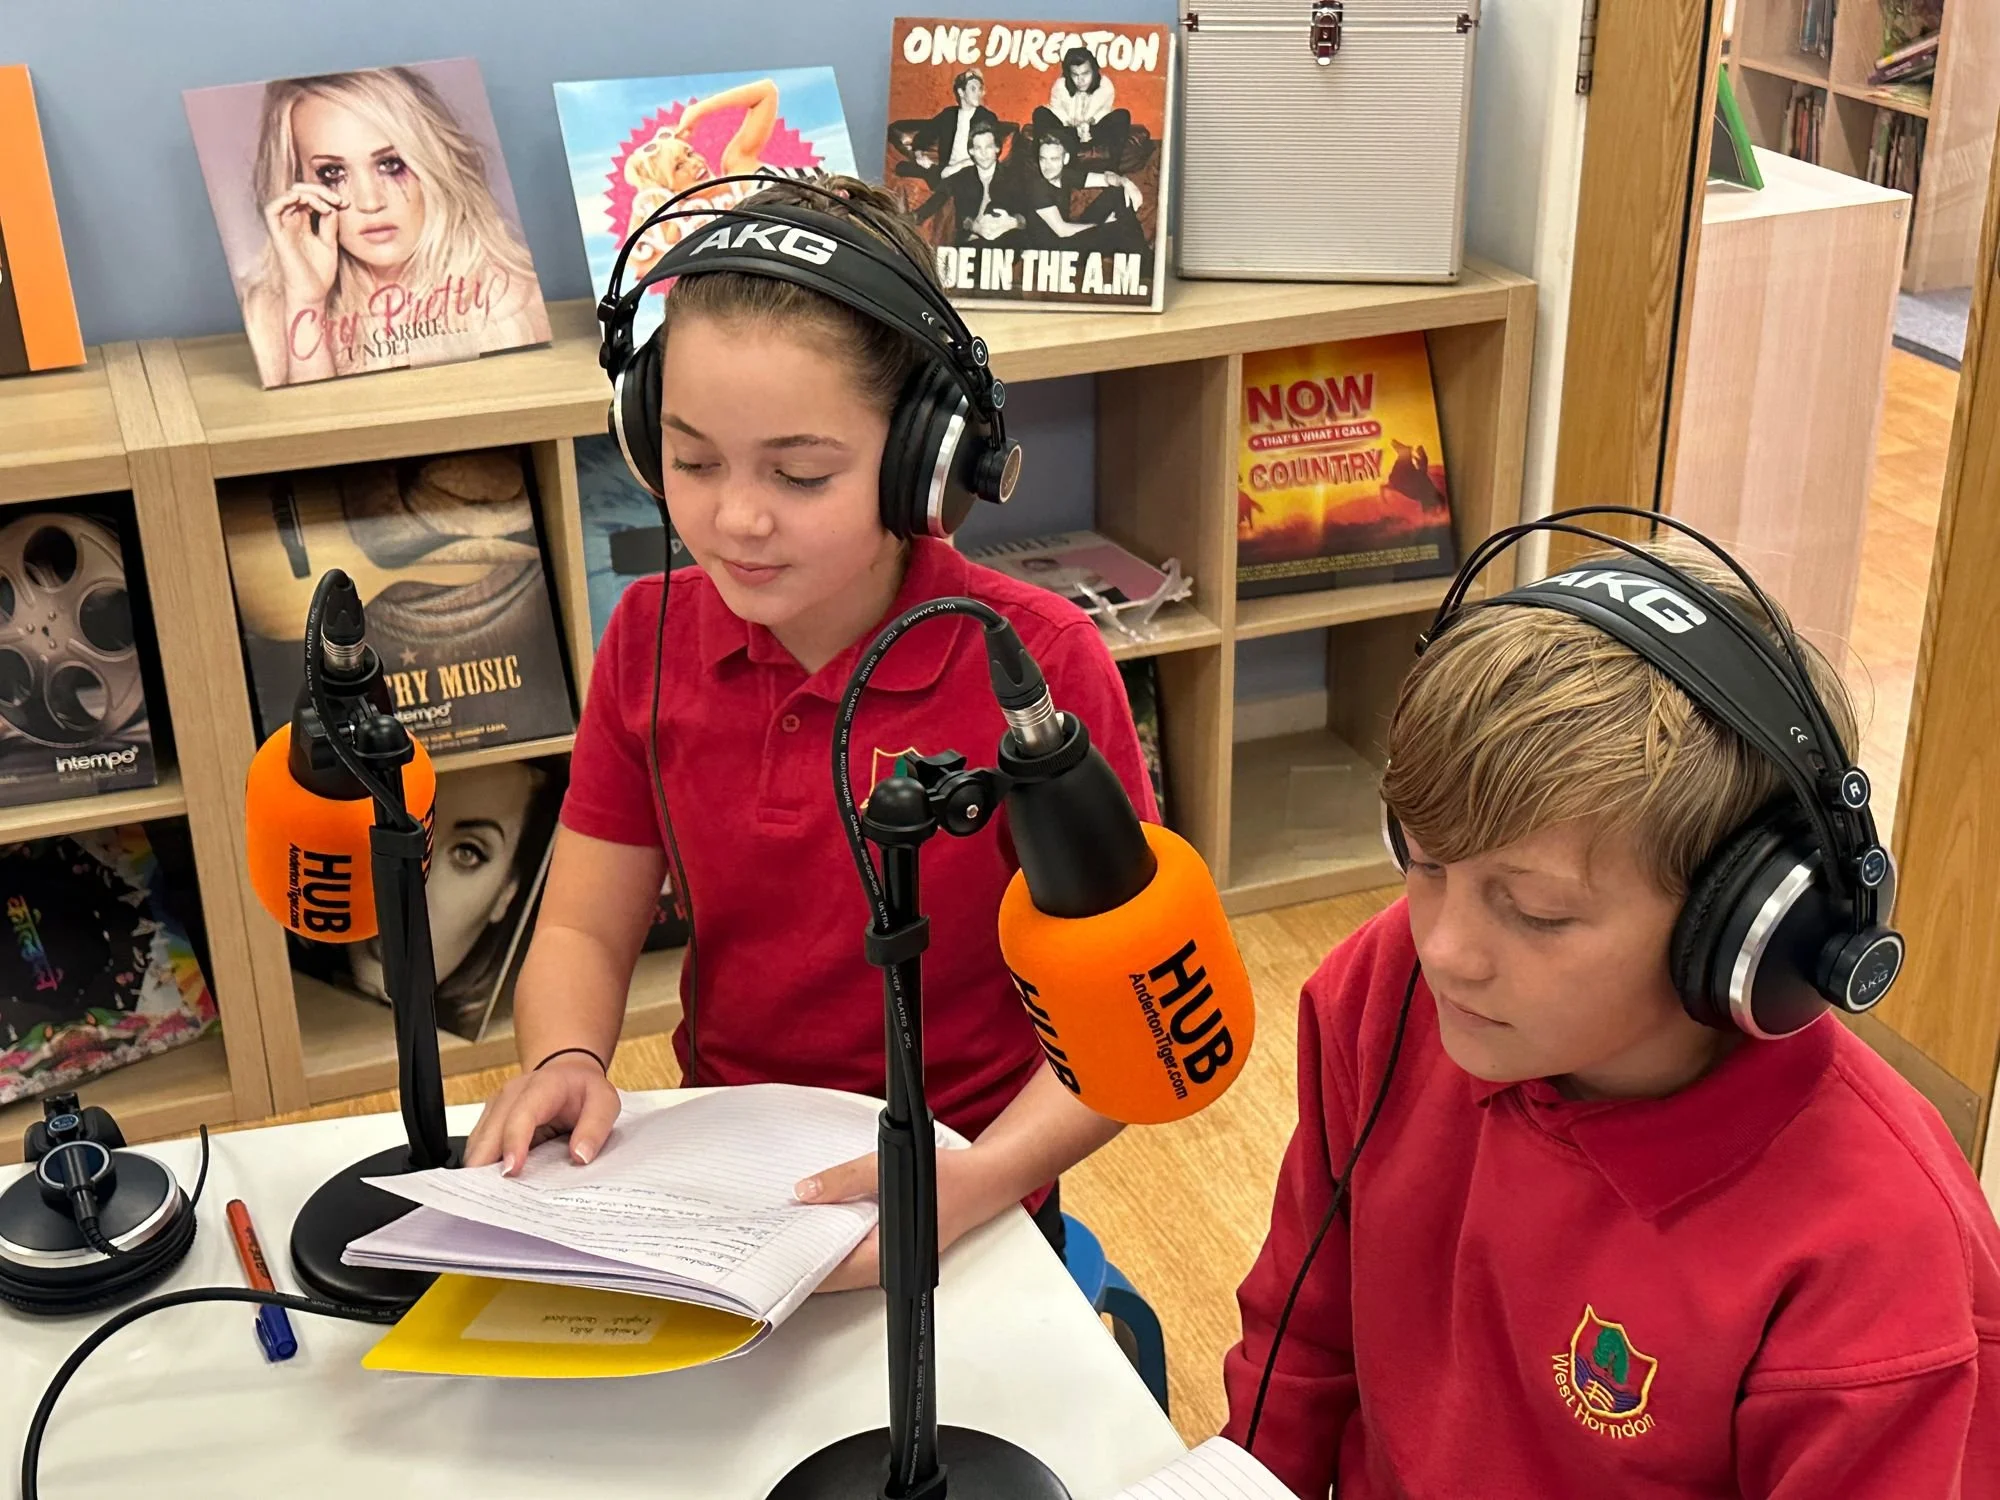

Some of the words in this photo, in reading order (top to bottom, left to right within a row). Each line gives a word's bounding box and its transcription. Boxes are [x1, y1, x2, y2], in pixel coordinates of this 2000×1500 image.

[903, 25, 982, 66] ONE
[984, 25, 1160, 72] DIRECTION
[689, 223, 838, 266] AKG
[936, 246, 977, 289] DE
[979, 248, 1015, 291] IN
[1020, 250, 1080, 293] THE
[1081, 251, 1149, 296] A.M.
[289, 307, 359, 361] Cry
[368, 265, 511, 338] Pretty
[1246, 373, 1375, 425] NOW
[1261, 432, 1300, 448] THAT'S
[1301, 428, 1332, 442] WHAT
[1341, 424, 1370, 438] CALL
[1249, 449, 1384, 492] COUNTRY
[1526, 570, 1708, 634] AKG
[878, 629, 899, 651] TOUR
[437, 654, 522, 700] MUSIC
[858, 654, 878, 682] GRADE
[844, 687, 861, 722] CLASSIC
[56, 750, 136, 773] intempo
[839, 752, 853, 808] MICROPHONE
[849, 813, 862, 842] CABLE
[302, 850, 352, 934] HUB
[877, 900, 890, 930] ULTRA
[1857, 969, 1889, 997] AKG
[1148, 938, 1234, 1085] HUB
[1128, 971, 1189, 1101] AndertonTiger.com
[1551, 1352, 1576, 1408] West
[1574, 1402, 1657, 1440] Horndon
